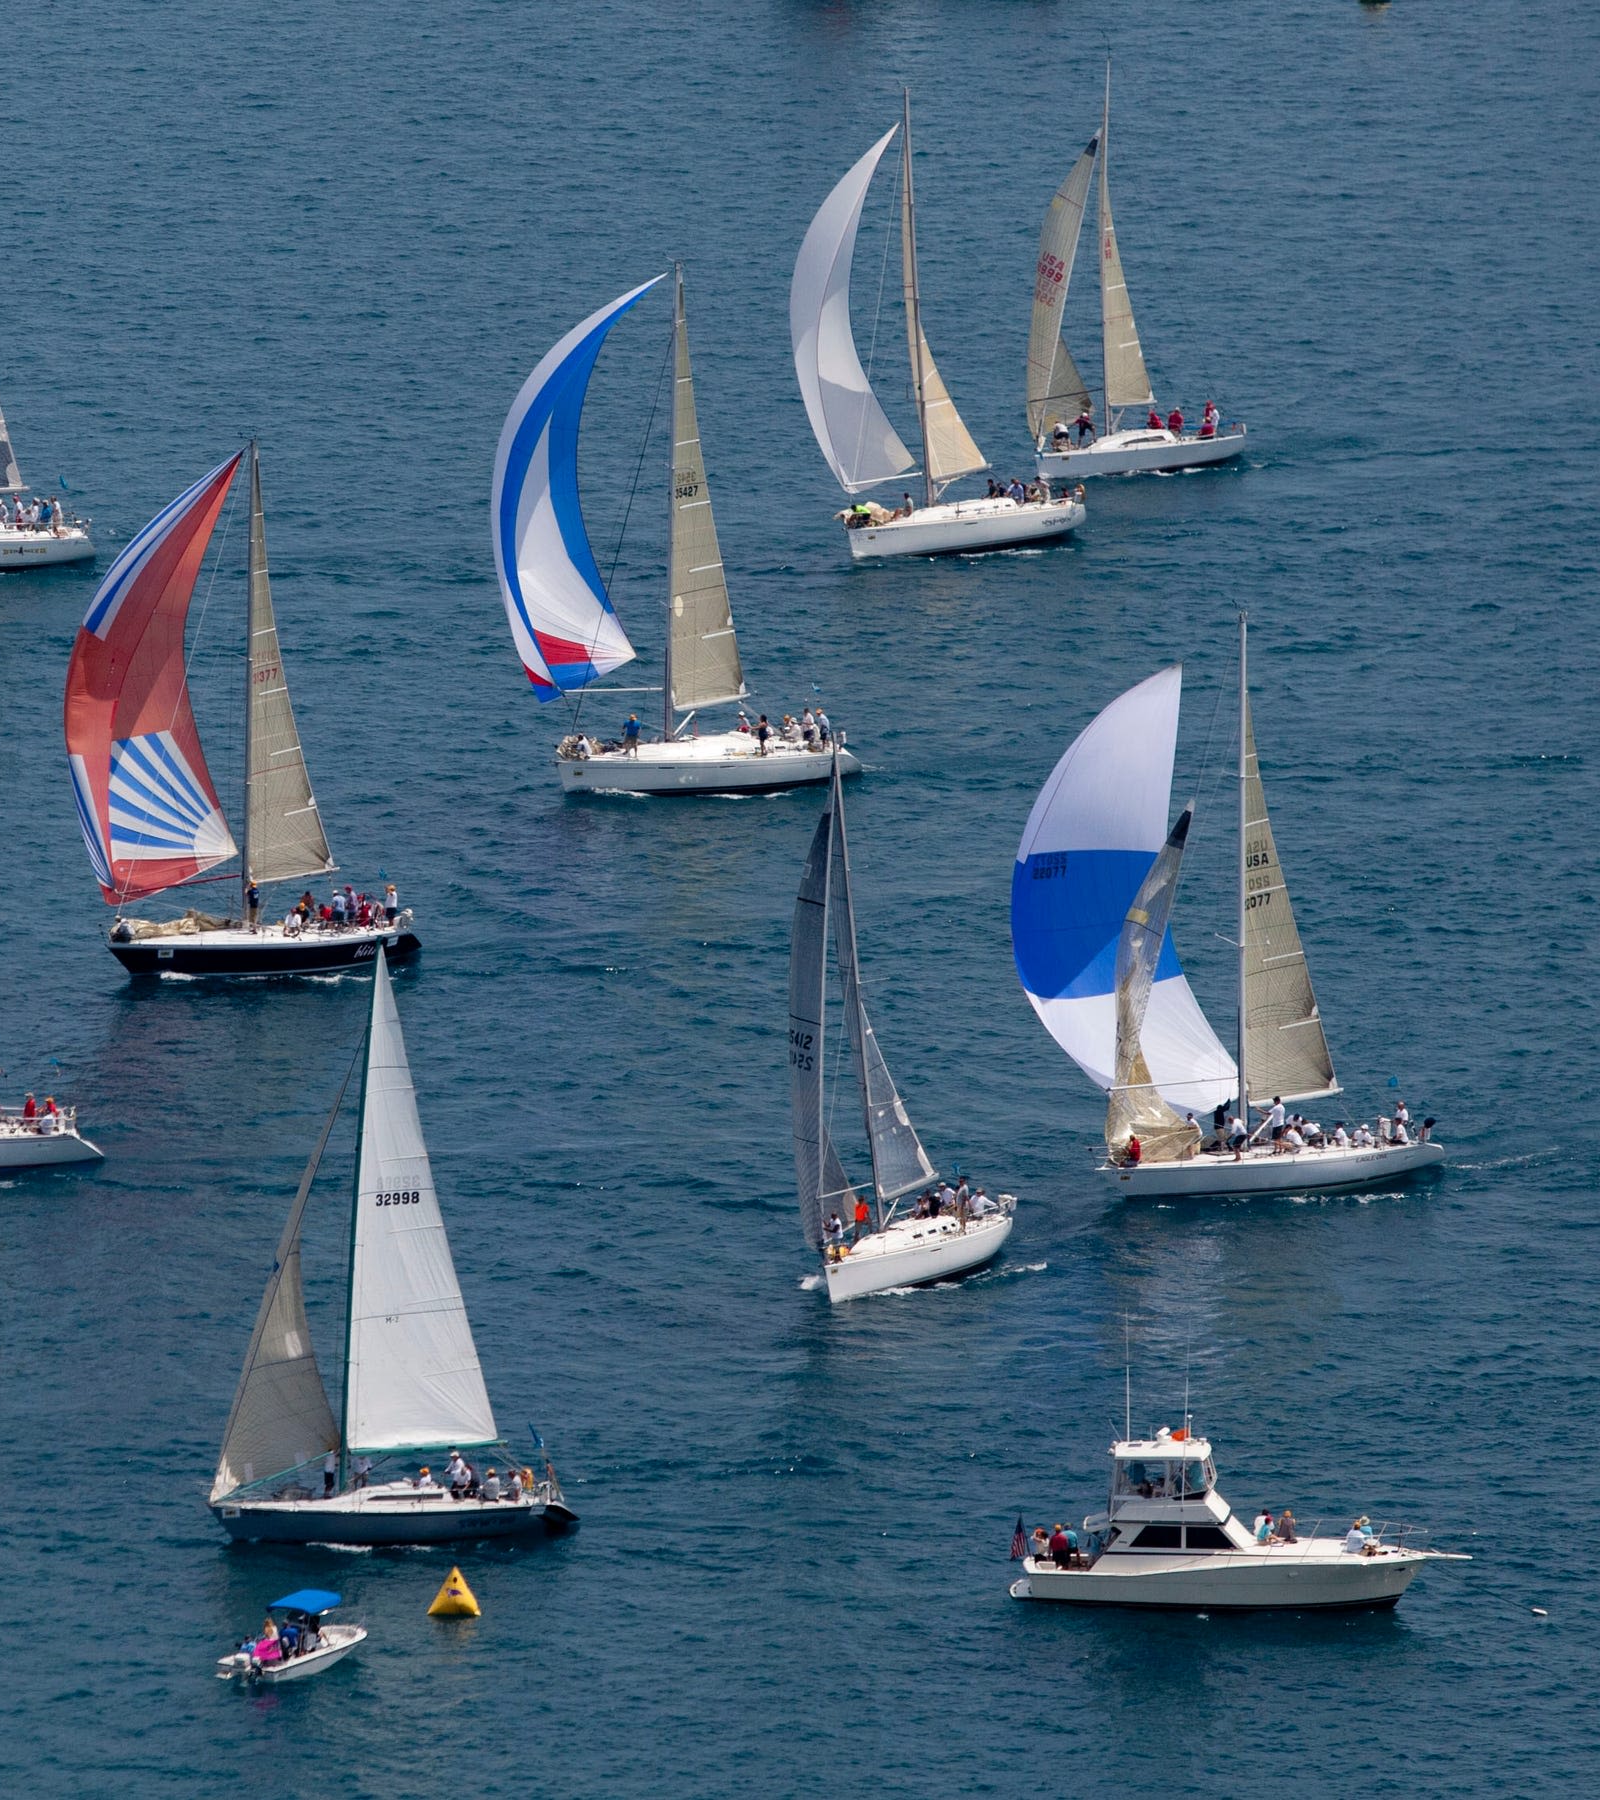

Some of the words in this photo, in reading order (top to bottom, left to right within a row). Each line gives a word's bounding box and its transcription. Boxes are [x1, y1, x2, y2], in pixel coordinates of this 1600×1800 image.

[1042, 251, 1065, 271] USA
[1246, 853, 1269, 868] USA
[375, 1191, 420, 1207] 32998
